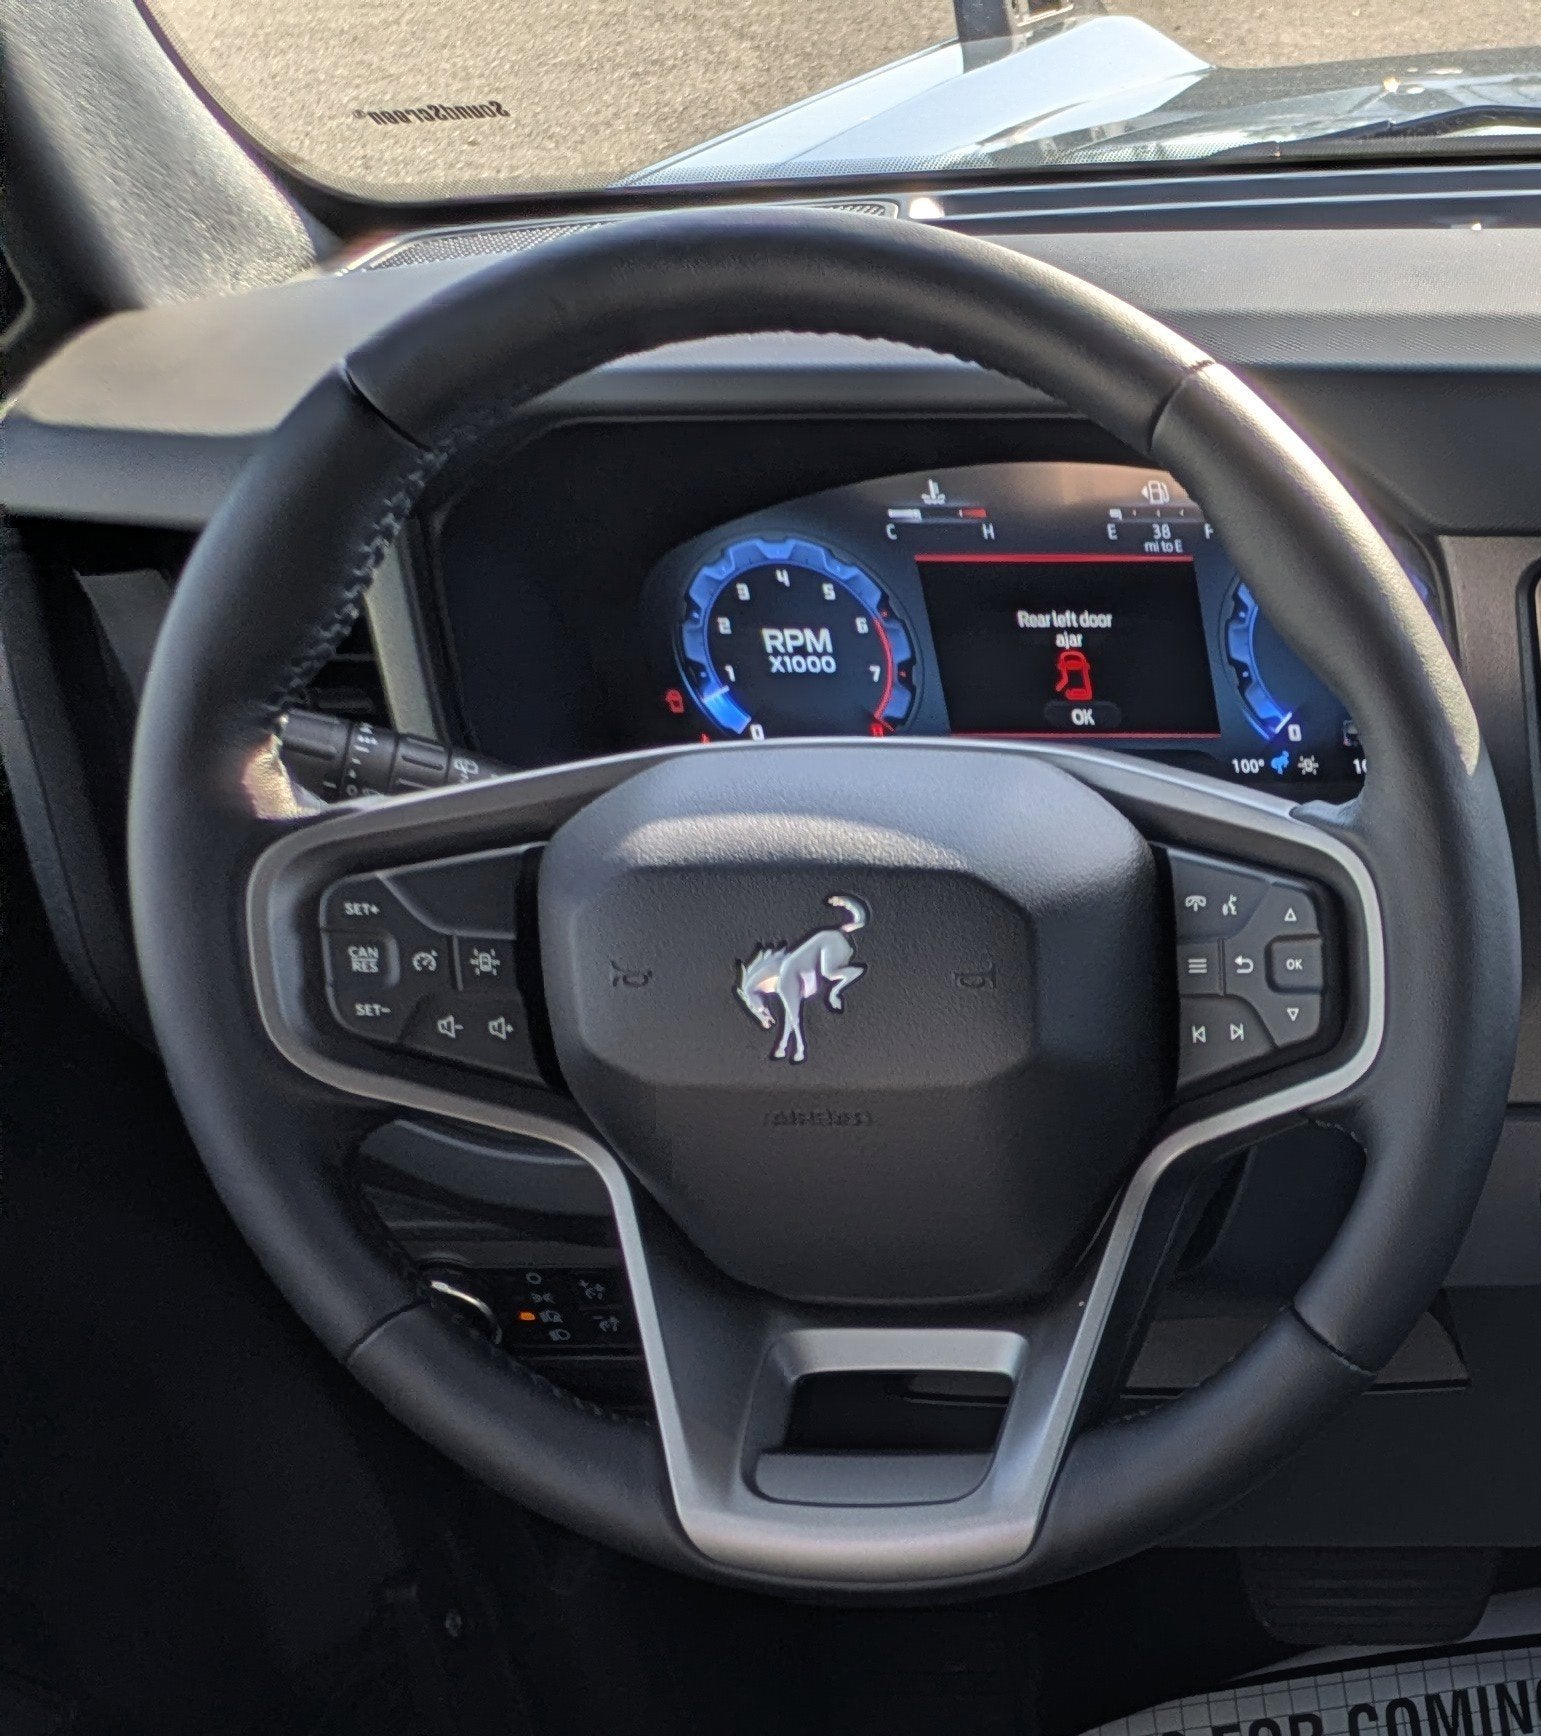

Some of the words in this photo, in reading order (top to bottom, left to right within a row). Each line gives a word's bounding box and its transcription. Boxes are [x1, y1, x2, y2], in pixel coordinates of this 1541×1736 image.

[1017, 611, 1050, 629] Rear
[1052, 611, 1078, 629] left
[1080, 611, 1113, 629] door
[761, 628, 833, 654] RPM
[1056, 632, 1083, 649] ajar
[768, 656, 837, 674] X1000
[1071, 709, 1096, 726] OK
[348, 945, 379, 959] CAN
[352, 959, 379, 974] RES
[1286, 958, 1303, 971] OK
